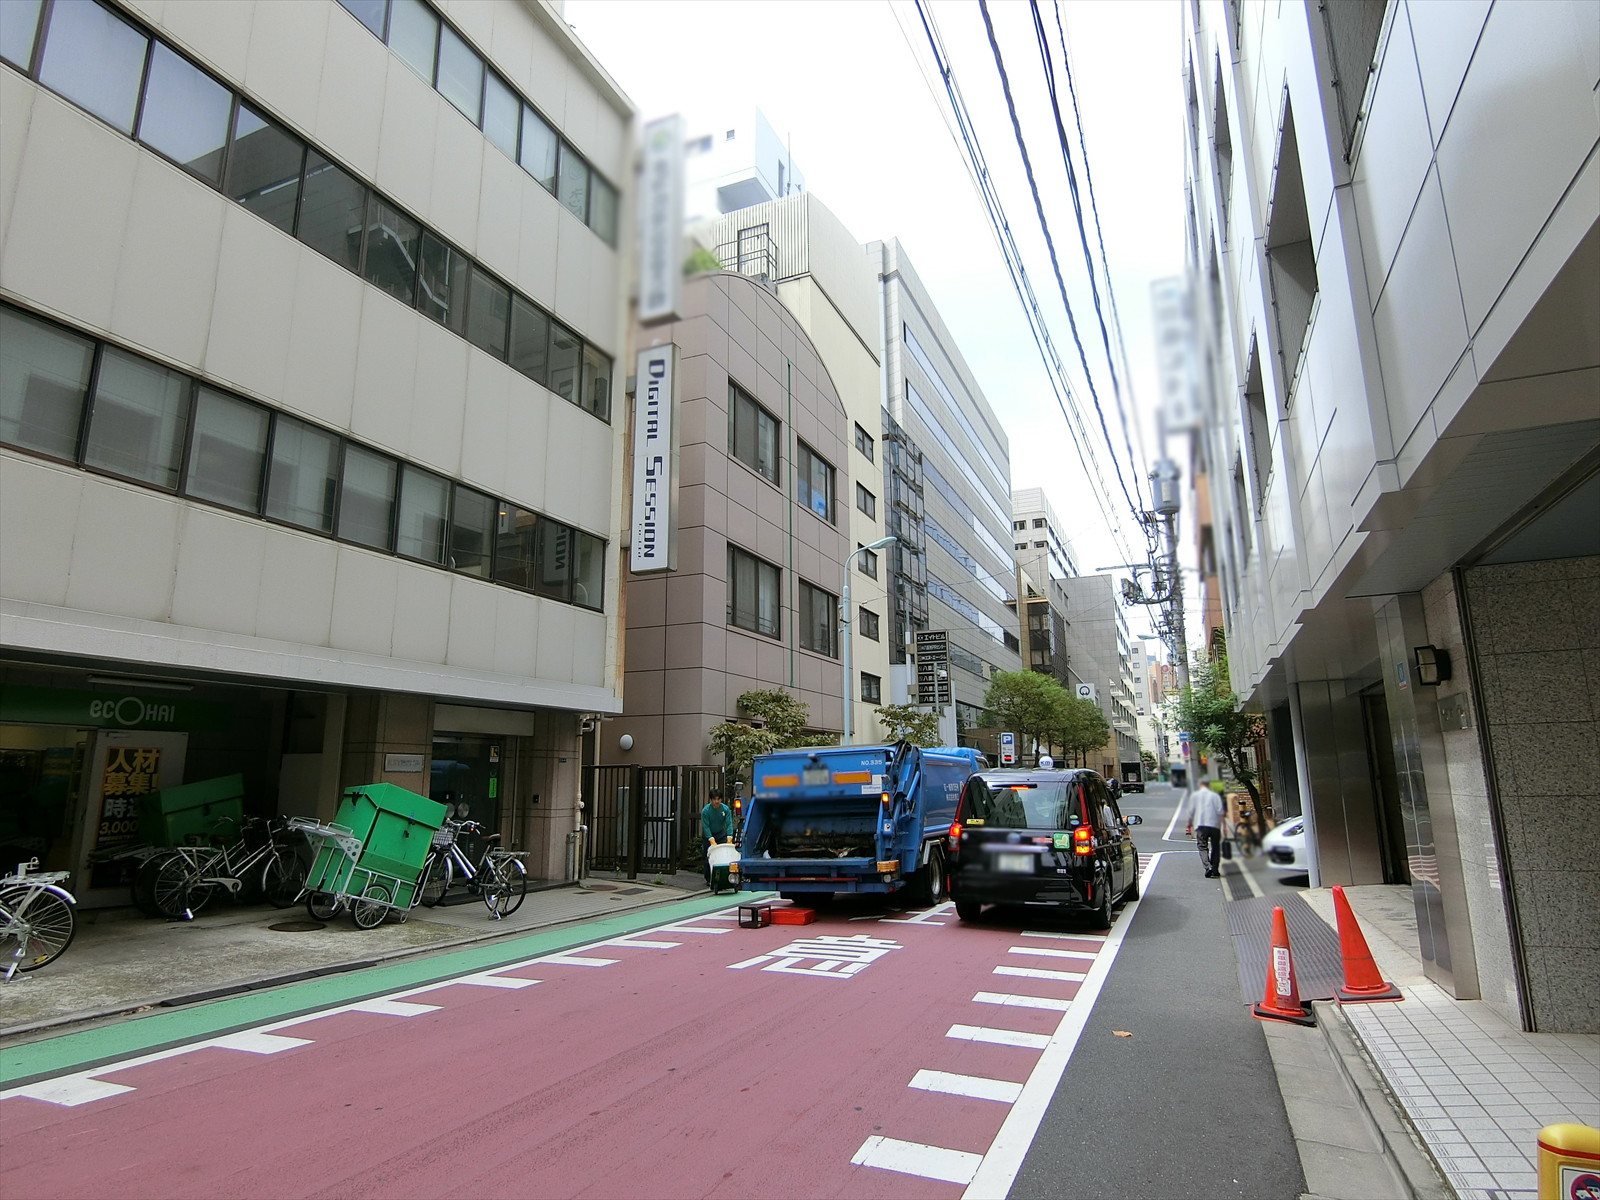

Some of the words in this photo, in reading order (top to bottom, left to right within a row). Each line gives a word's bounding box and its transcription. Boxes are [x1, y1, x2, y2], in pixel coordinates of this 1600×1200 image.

[646, 359, 665, 447] DIGITAL
[644, 456, 663, 558] SESSION
[107, 748, 159, 773] 人材
[1003, 735, 1012, 743] P
